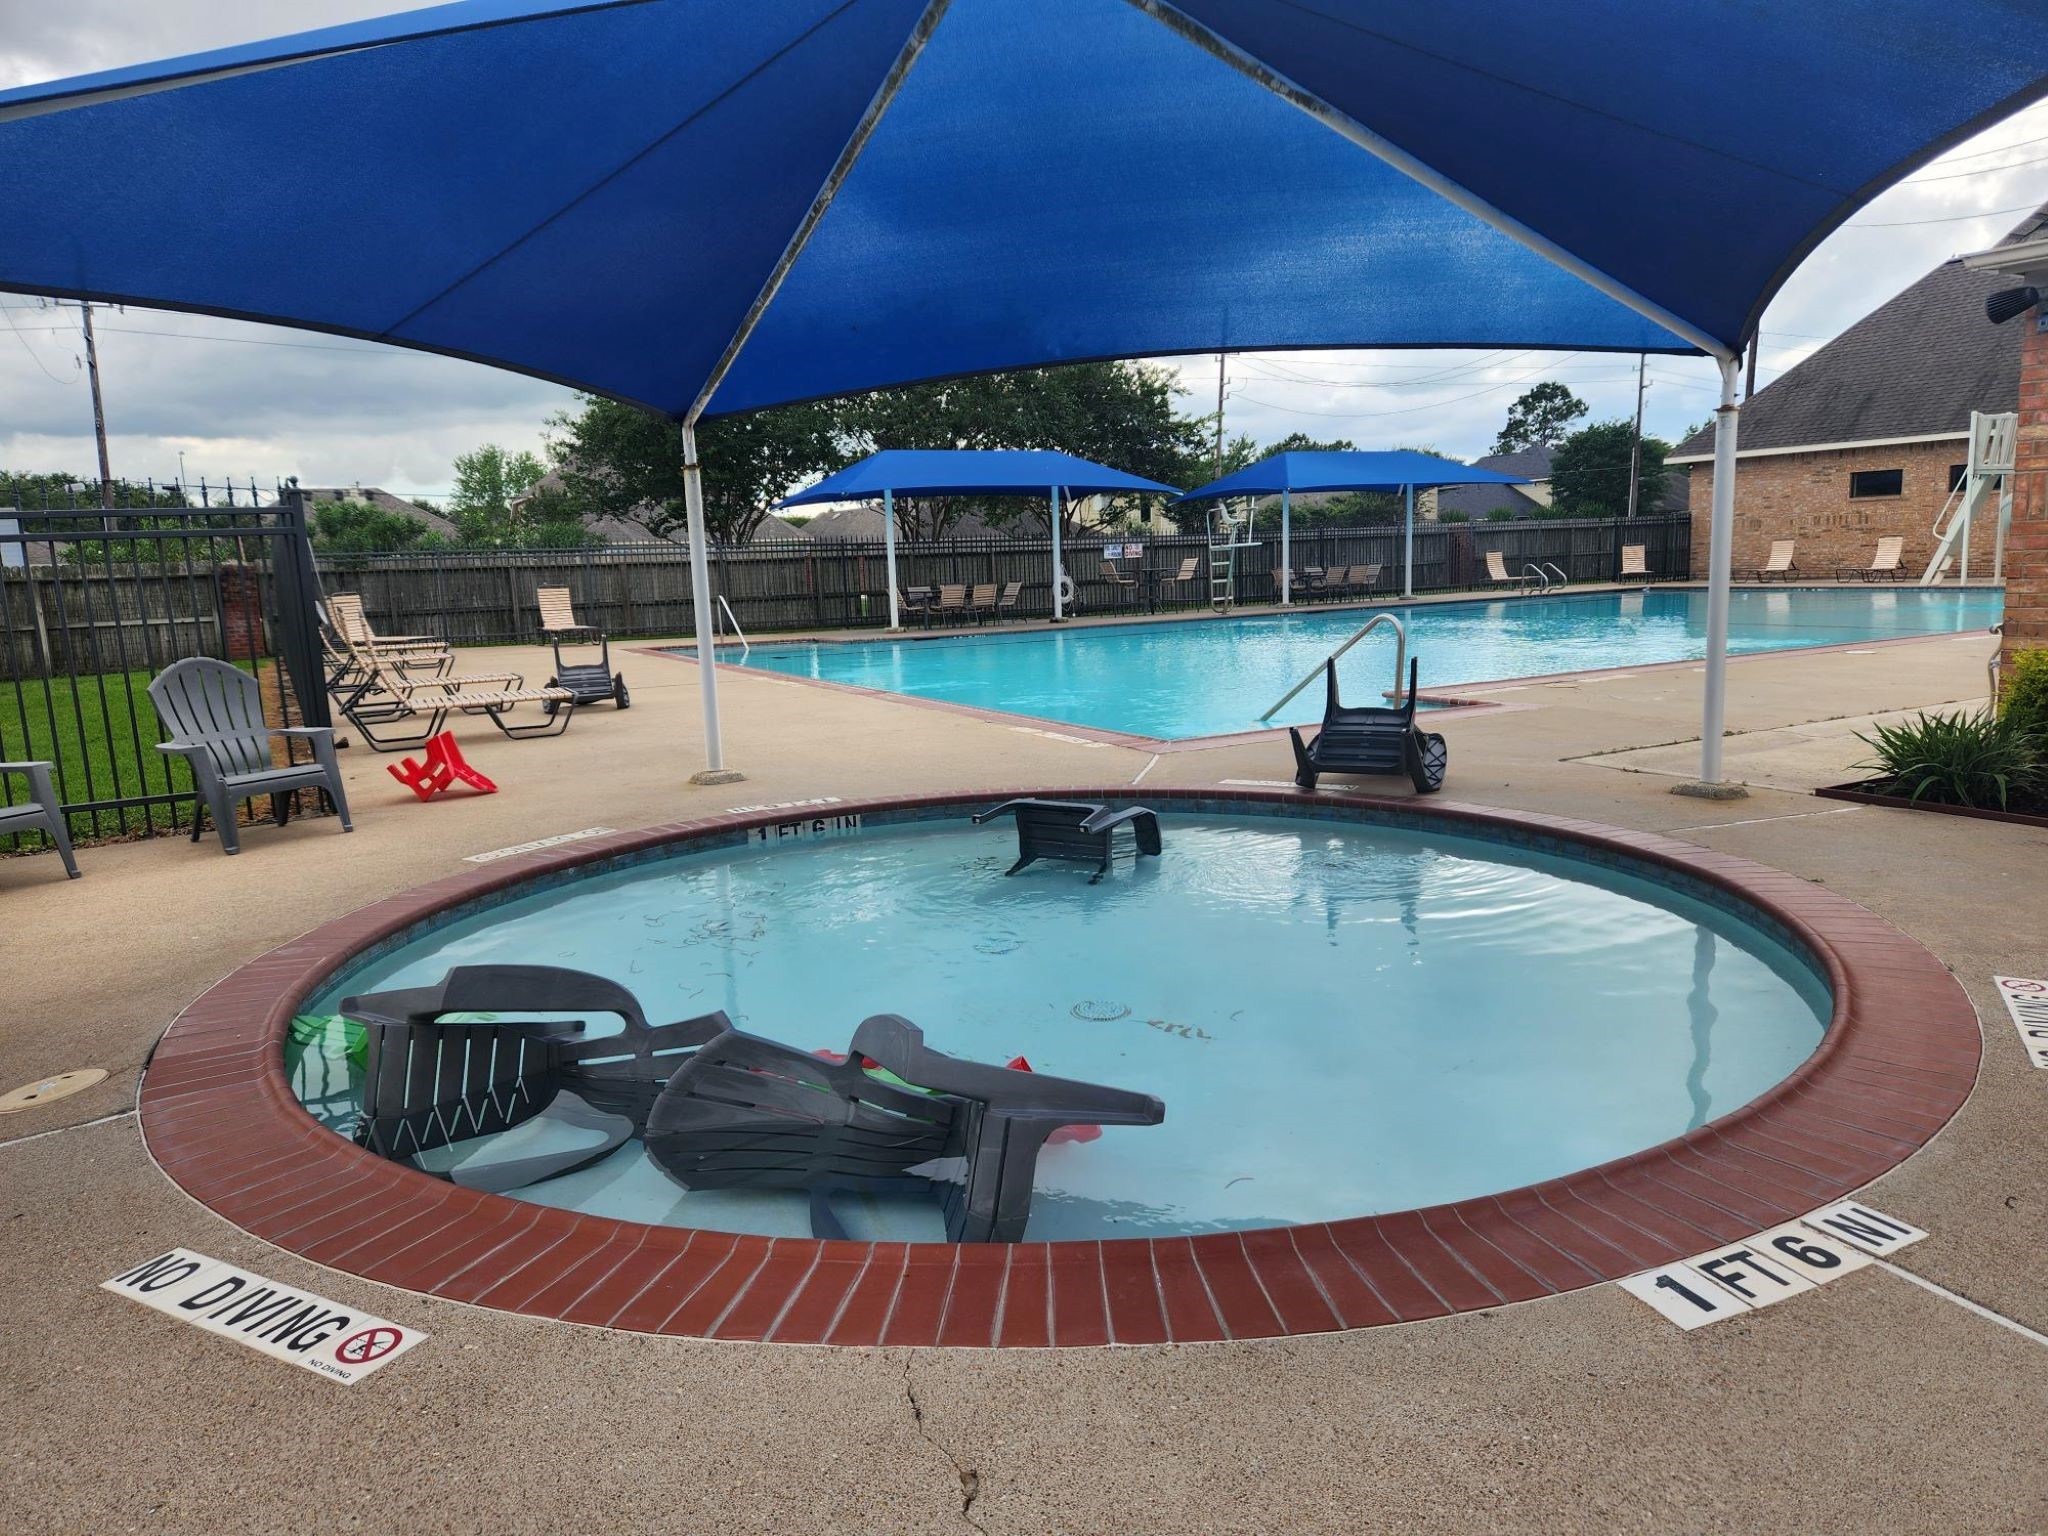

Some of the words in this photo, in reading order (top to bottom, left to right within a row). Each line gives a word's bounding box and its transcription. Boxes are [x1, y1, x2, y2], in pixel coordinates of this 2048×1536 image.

[758, 827, 767, 840] 1
[778, 822, 801, 837] FT
[836, 815, 857, 829] IN
[1655, 1274, 1718, 1312] 1
[1697, 1250, 1791, 1299] FT
[1772, 1236, 1842, 1269] 6
[115, 1253, 202, 1293] NO
[178, 1276, 350, 1354] DIVING
[308, 1359, 323, 1367] NO
[321, 1364, 351, 1379] DIVING
